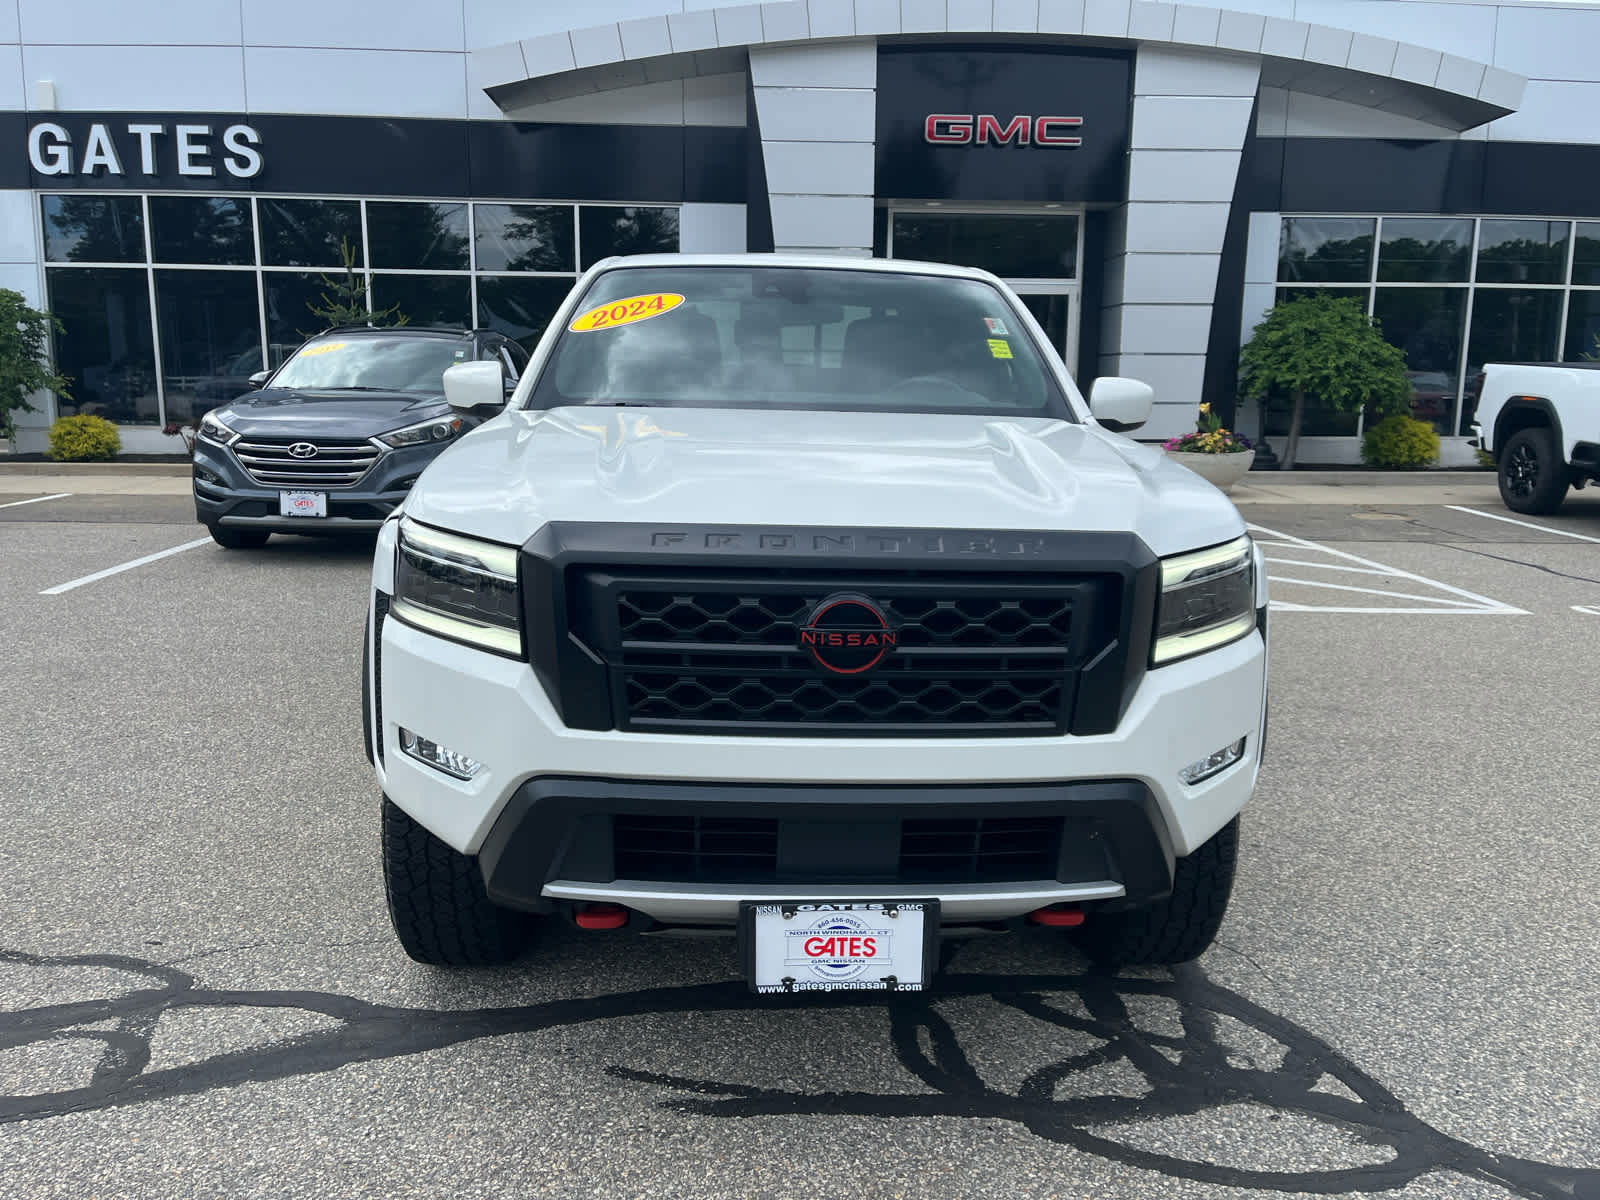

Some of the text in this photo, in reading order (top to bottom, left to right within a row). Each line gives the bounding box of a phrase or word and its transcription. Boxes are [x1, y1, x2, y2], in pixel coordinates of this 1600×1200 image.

[925, 114, 1083, 146] GMC
[28, 122, 263, 178] GATES
[591, 295, 666, 328] 2024
[801, 631, 897, 646] NISSAN
[756, 905, 782, 915] NISSAN
[804, 937, 876, 957] GATES
